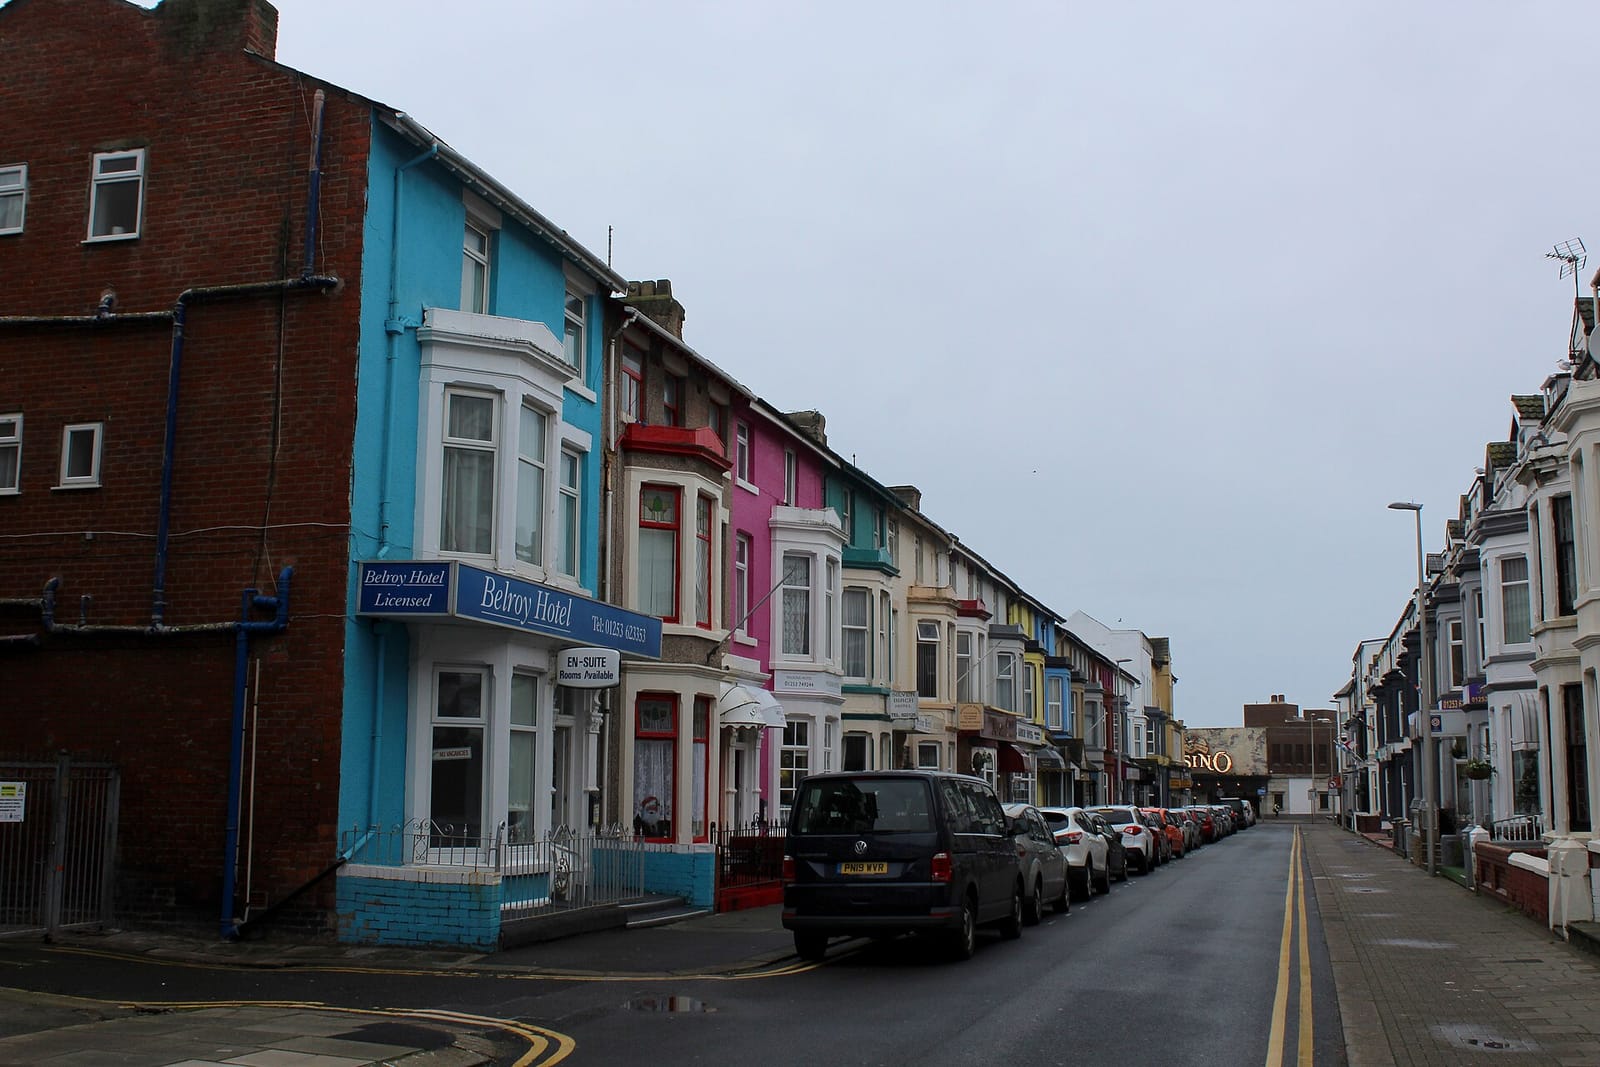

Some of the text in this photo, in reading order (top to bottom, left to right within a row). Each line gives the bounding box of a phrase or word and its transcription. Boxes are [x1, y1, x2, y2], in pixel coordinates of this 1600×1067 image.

[365, 570, 445, 587] Belroy Hotel
[374, 593, 433, 608] Licensed
[480, 576, 573, 627] Belroy Hotel
[591, 615, 647, 643] Tel: 01253 623353
[567, 656, 607, 669] EN-SUITE
[559, 669, 614, 681] Rooms Available
[844, 863, 884, 872] PN19 WVR
